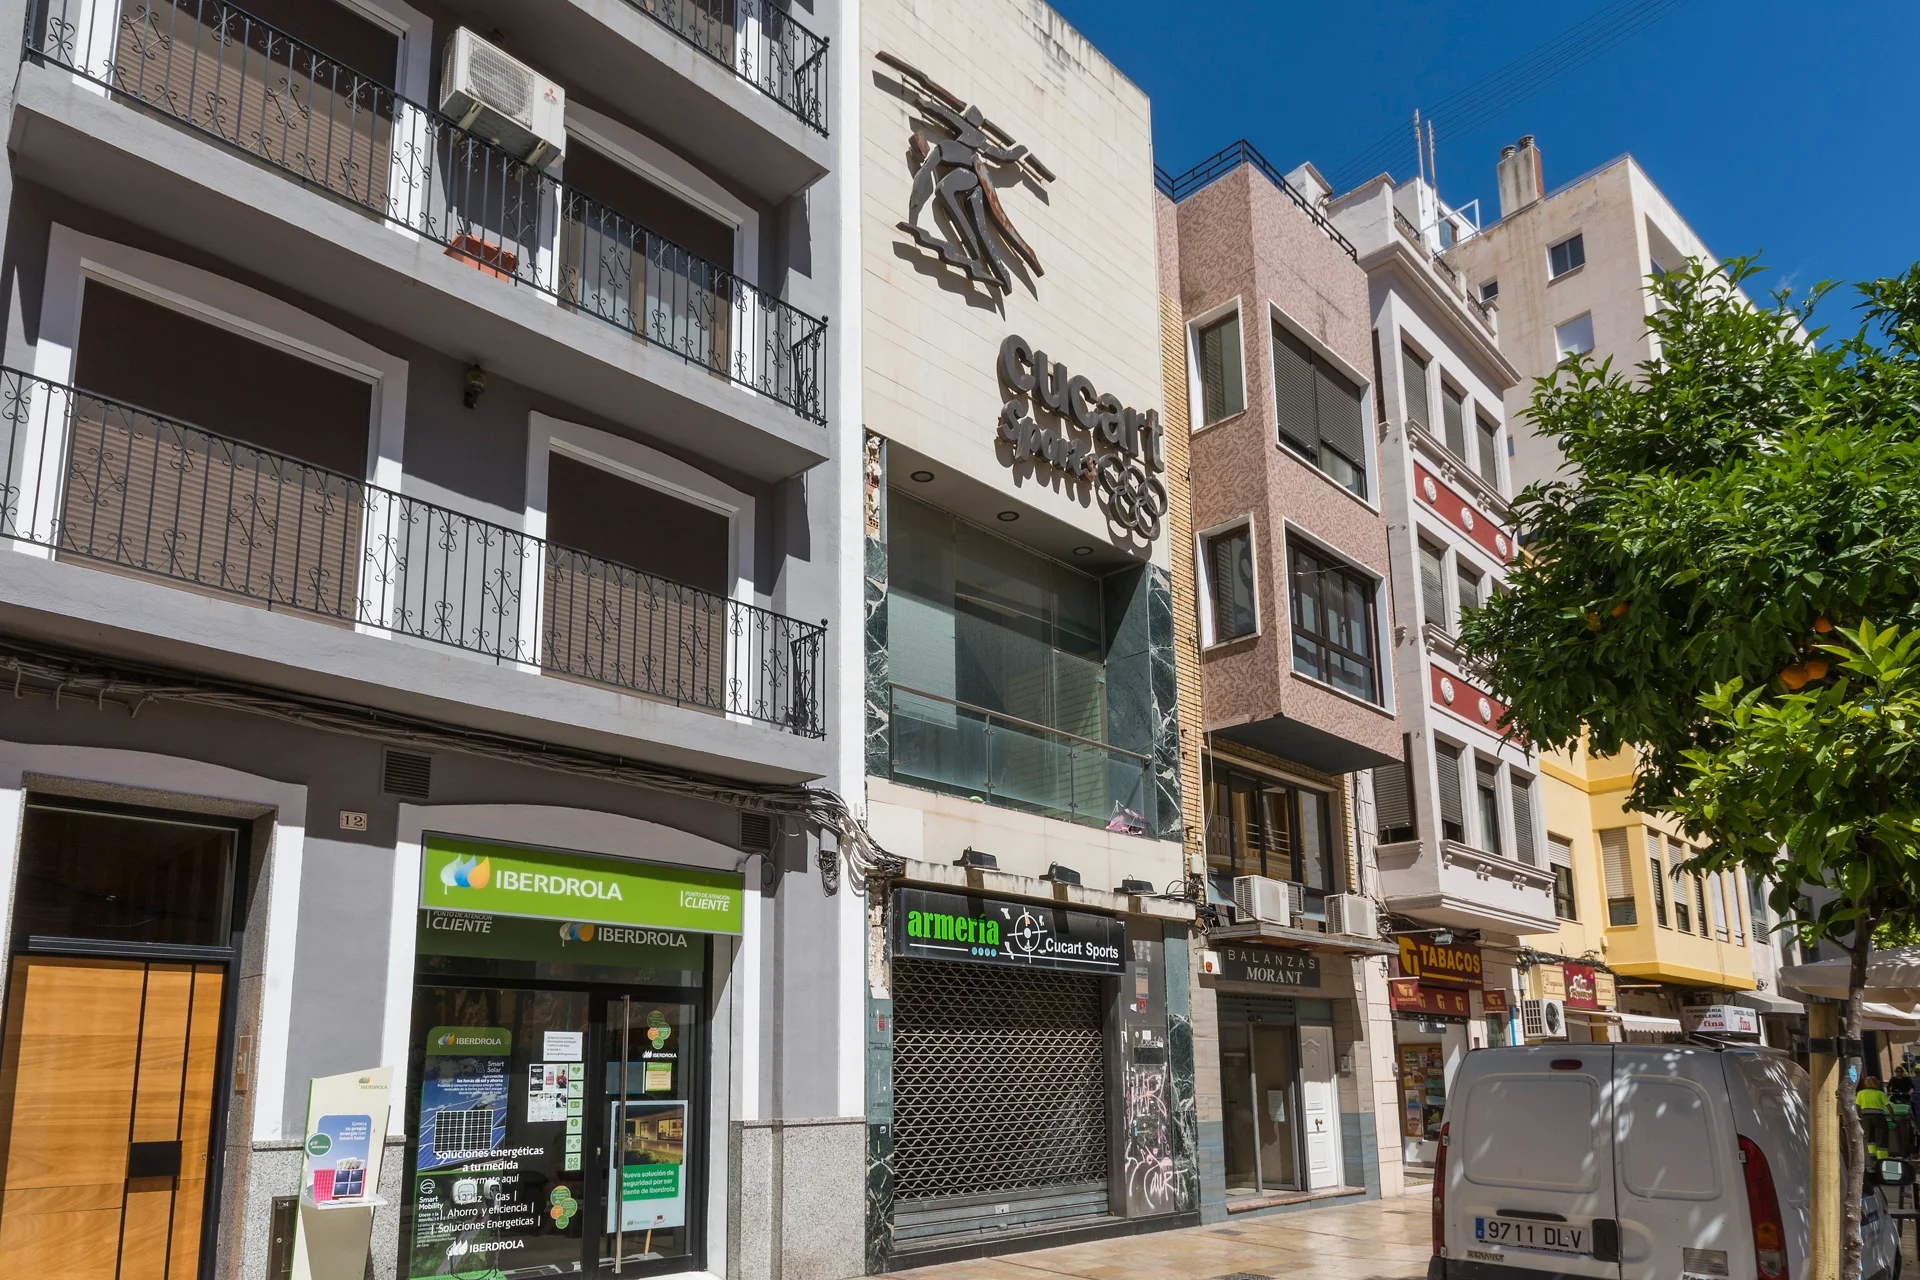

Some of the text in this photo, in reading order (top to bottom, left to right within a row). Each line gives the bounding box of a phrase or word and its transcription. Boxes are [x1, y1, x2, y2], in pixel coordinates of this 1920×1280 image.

[345, 815, 363, 827] 12
[496, 870, 622, 901] IBERDROLA
[685, 897, 730, 912] CLIENTE
[432, 917, 492, 933] CLIENTE
[908, 910, 1000, 946] armería
[598, 927, 687, 948] IBERDROLA
[1045, 937, 1119, 960] Cucart Sports
[1228, 949, 1315, 969] BALANZAS
[1420, 945, 1480, 974] TABACOS
[1246, 966, 1302, 985] MORANT
[456, 1037, 501, 1045] IBERDROLA
[436, 1146, 544, 1160] Soluciones energéticas
[462, 1160, 518, 1172] a tu medida
[501, 1174, 519, 1185] aquí
[418, 1202, 443, 1211] Mobility
[419, 1196, 438, 1204] Smart
[447, 1203, 528, 1218] Ahorro y eficiencia
[438, 1222, 485, 1233] Soluciones
[1488, 1222, 1582, 1249] 9711 DLV
[469, 1240, 524, 1253] IBERDROLA
[1467, 1250, 1504, 1262] RENAULT
